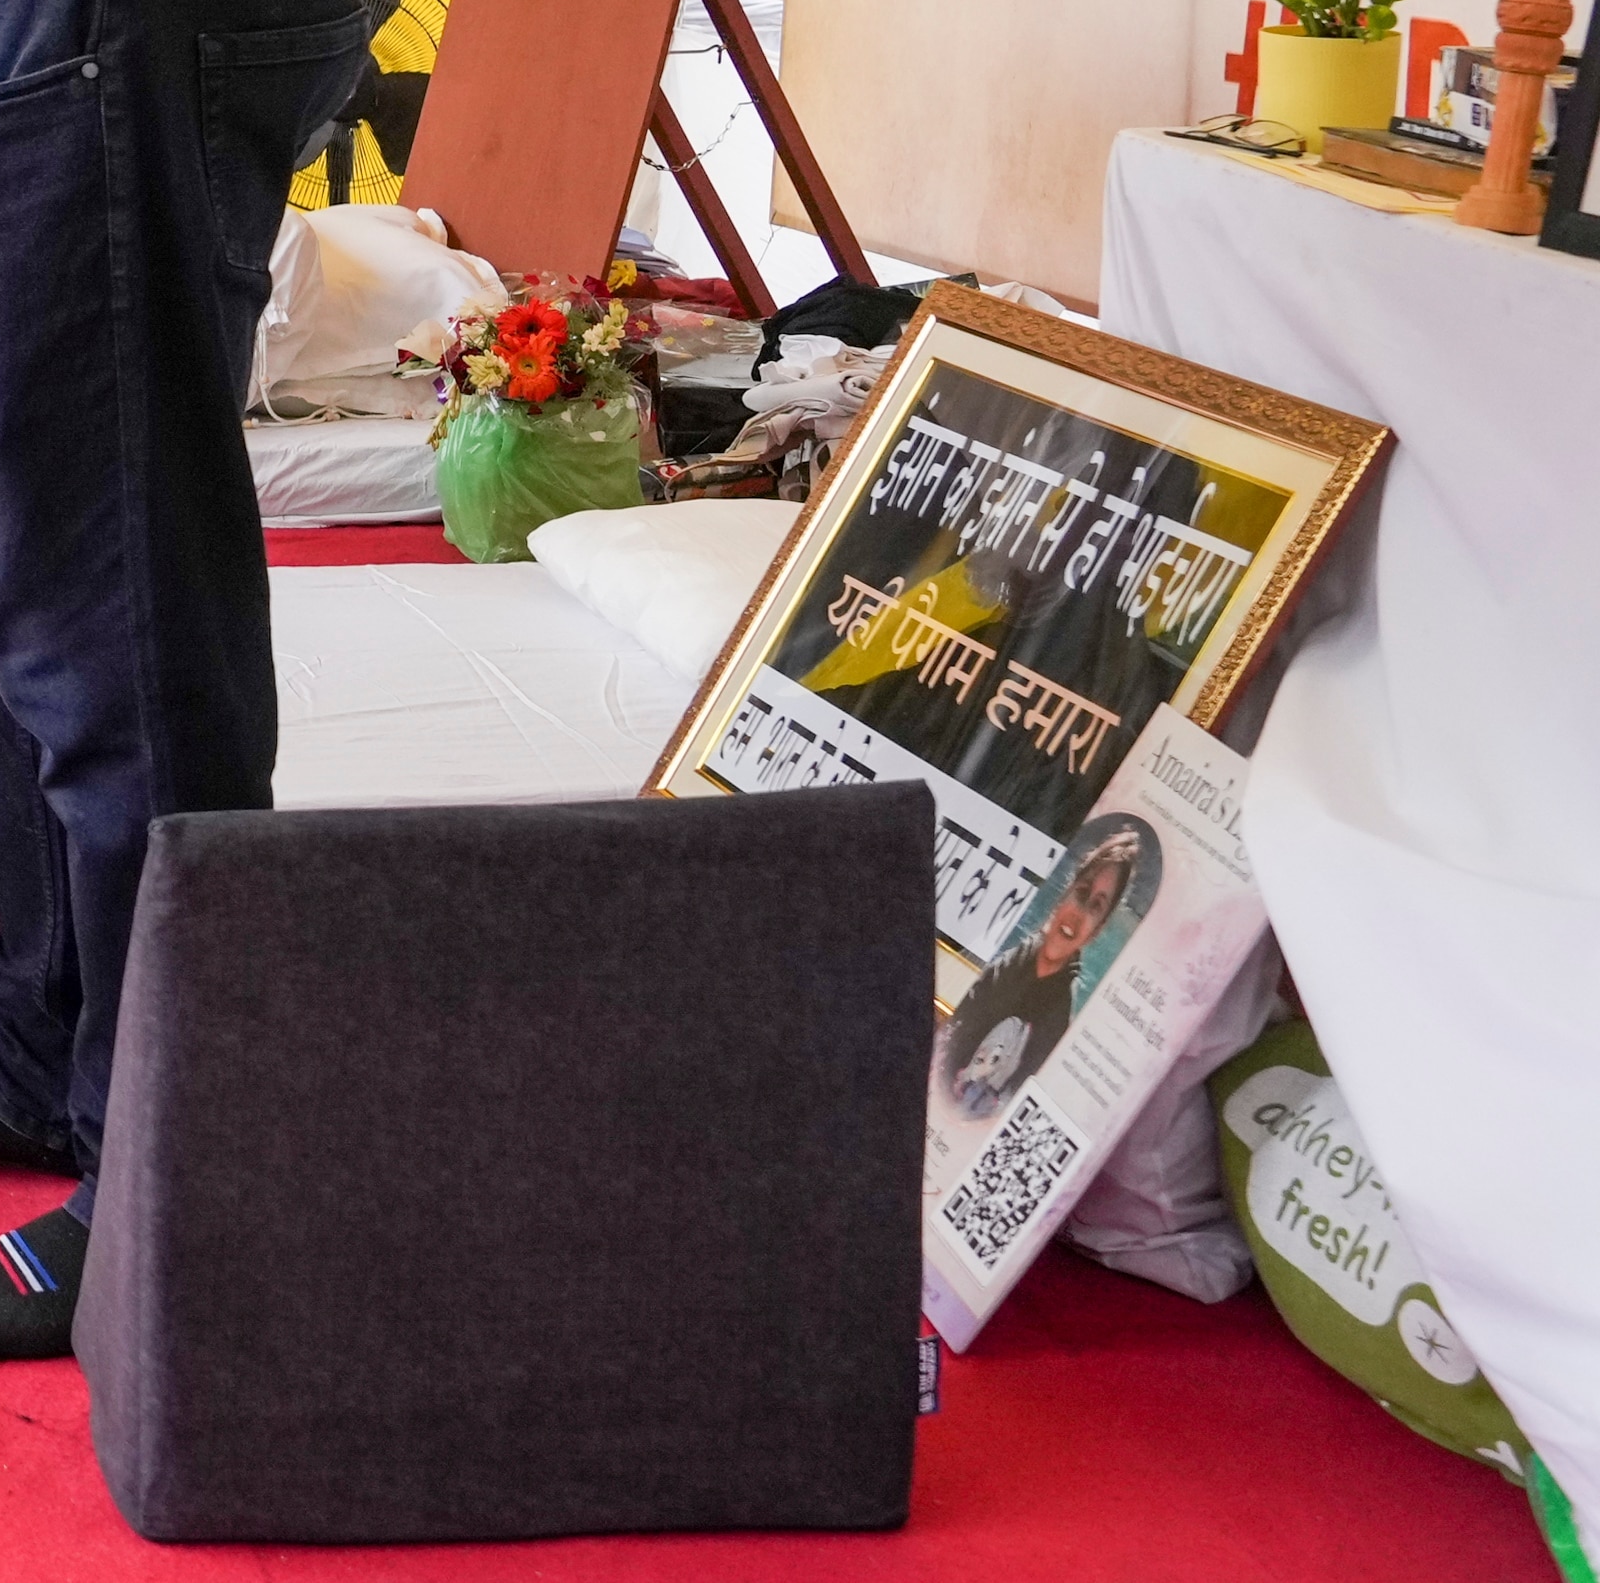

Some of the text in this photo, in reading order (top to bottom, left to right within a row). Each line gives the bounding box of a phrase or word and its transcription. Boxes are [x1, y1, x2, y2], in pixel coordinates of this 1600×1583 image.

[938, 439, 1002, 531] का
[1026, 450, 1106, 573] से
[1064, 465, 1147, 594] हो
[827, 574, 906, 651] यही
[890, 580, 997, 705] पैगाम
[985, 659, 1122, 776] हमारा
[1140, 733, 1235, 824] Amaira's
[1276, 1178, 1389, 1291] fresh!
